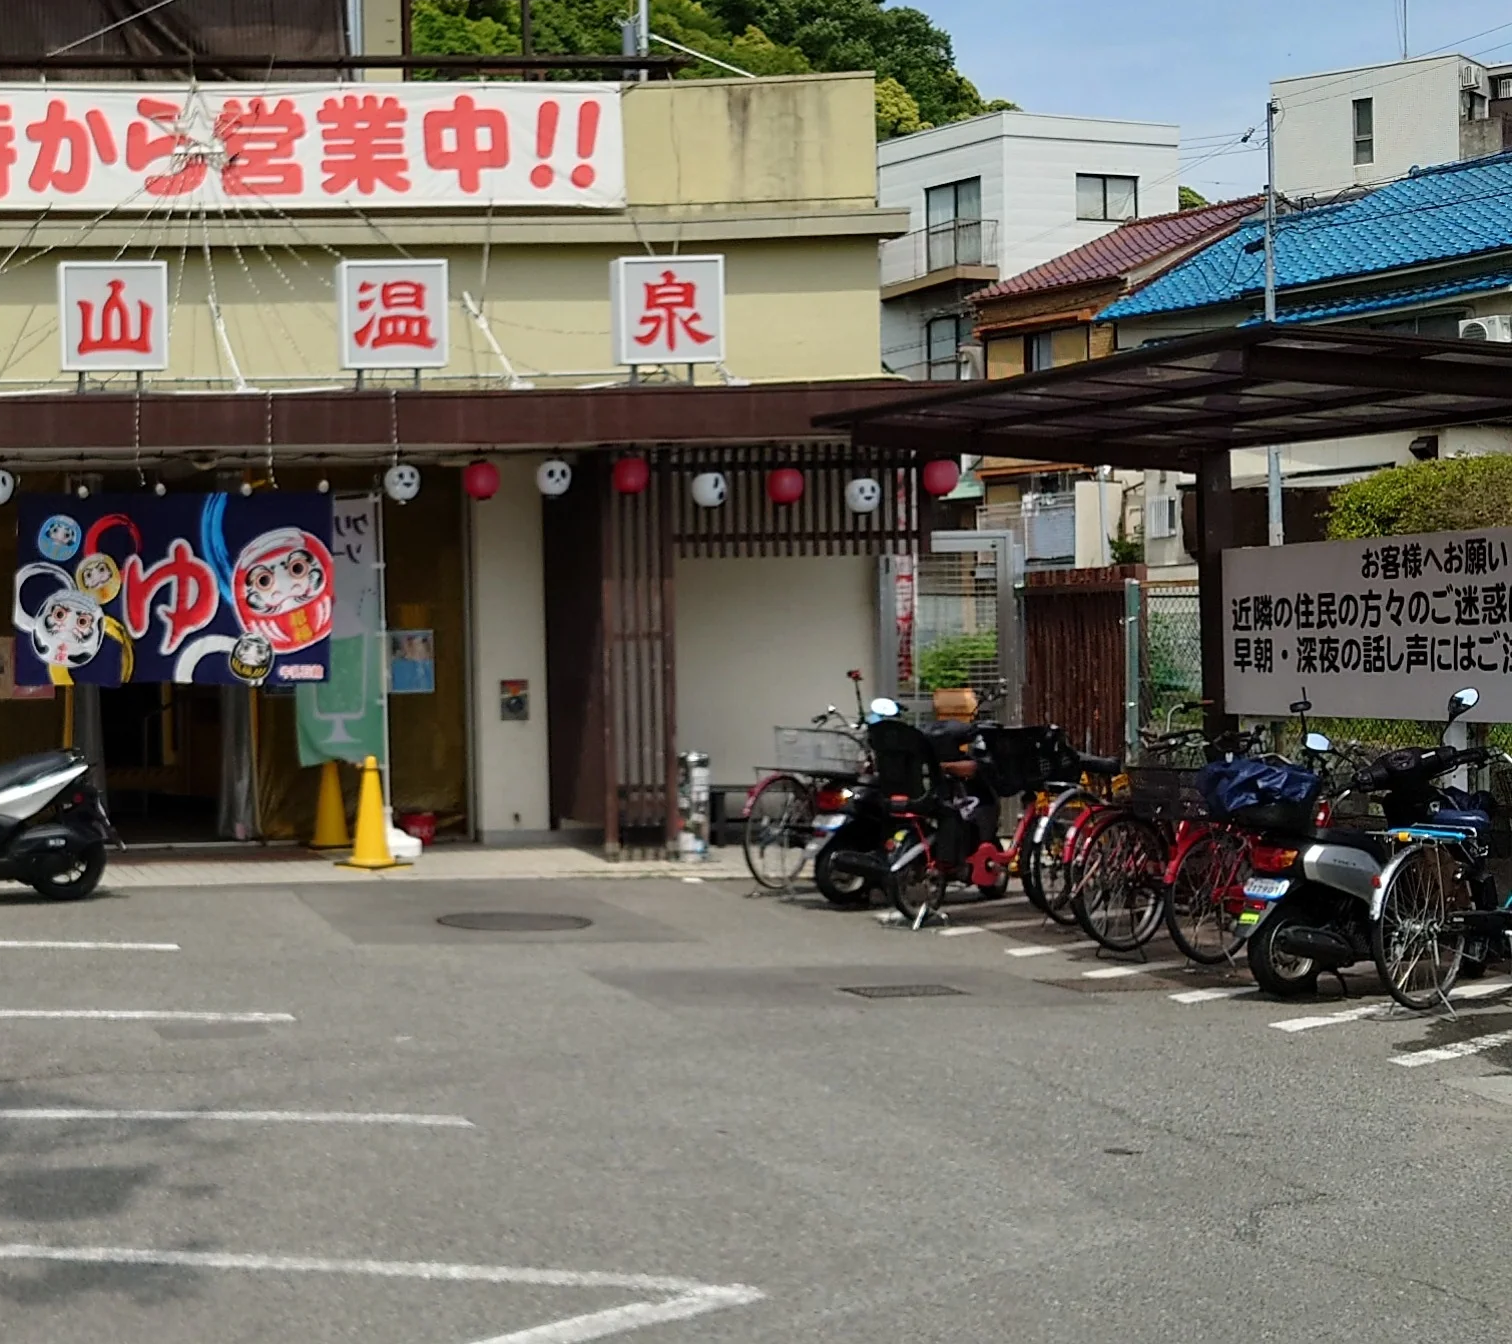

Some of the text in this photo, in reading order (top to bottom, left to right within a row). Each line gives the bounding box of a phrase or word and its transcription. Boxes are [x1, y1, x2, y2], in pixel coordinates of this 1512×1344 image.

[1360, 537, 1509, 580] お客様へお願い
[124, 540, 217, 652] ゆ
[1231, 582, 1512, 633] 近隣の住民の方々のご迷惑
